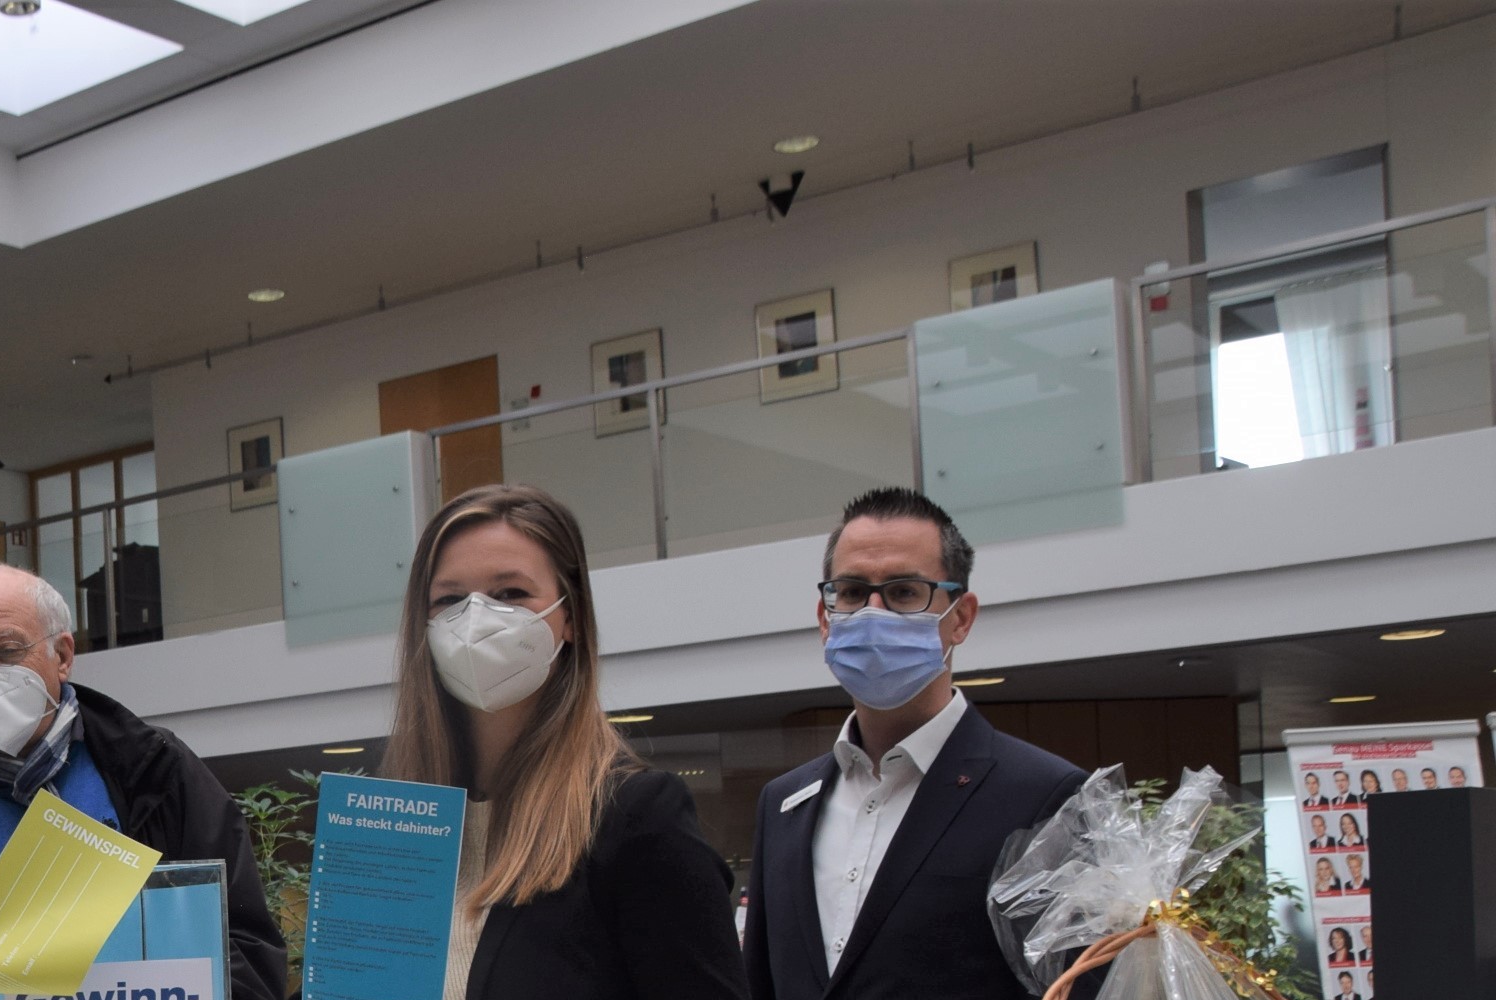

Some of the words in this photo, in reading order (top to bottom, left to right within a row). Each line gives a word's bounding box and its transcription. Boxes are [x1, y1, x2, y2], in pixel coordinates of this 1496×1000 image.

[346, 792, 439, 817] FAIRTRADE
[328, 812, 353, 827] Was
[355, 816, 392, 831] steckt
[394, 820, 451, 837] dahinter?
[42, 807, 140, 869] GEWINNSPIEL
